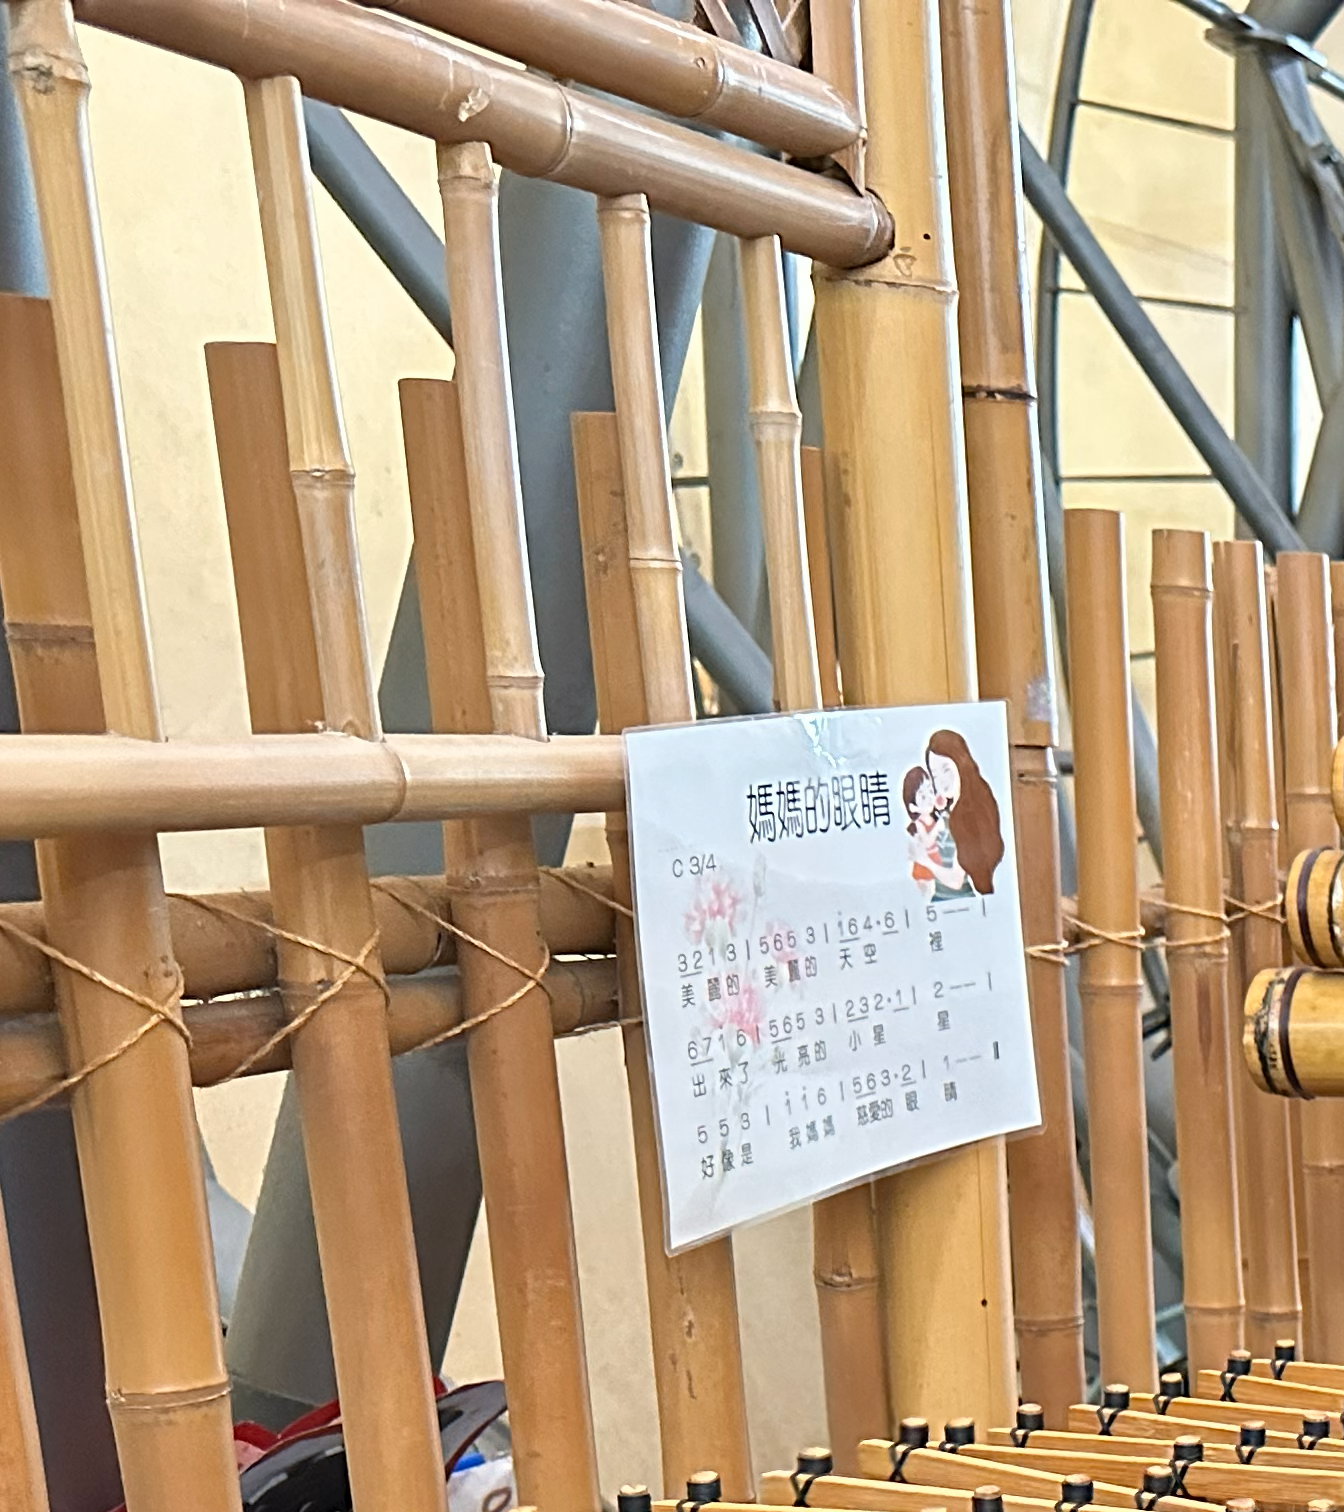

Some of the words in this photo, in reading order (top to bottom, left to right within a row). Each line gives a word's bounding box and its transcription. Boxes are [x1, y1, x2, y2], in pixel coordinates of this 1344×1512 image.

[746, 770, 891, 844] 媽媽的眼睛
[672, 858, 684, 878] C
[689, 854, 717, 876] 3/4
